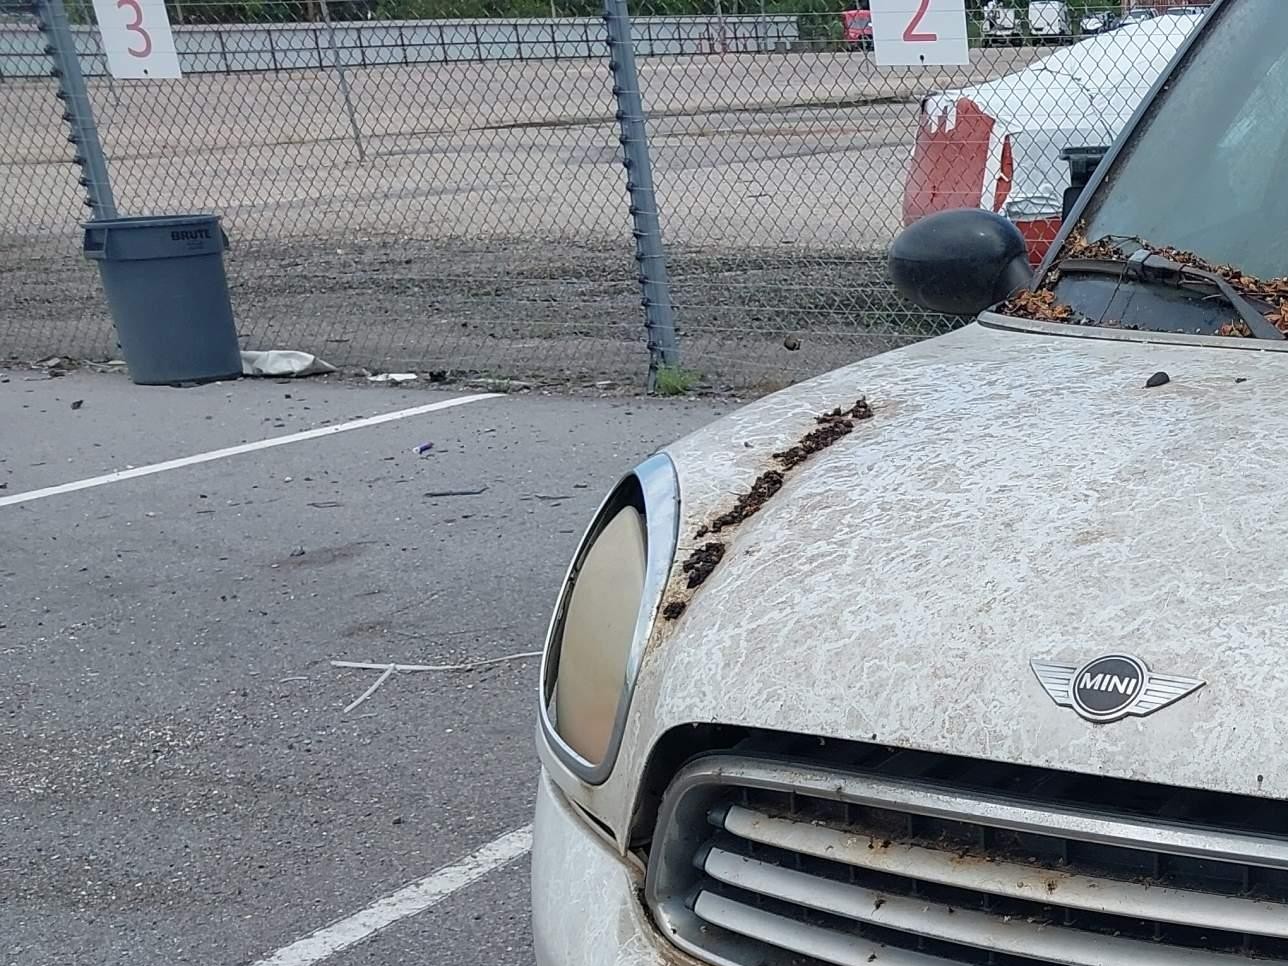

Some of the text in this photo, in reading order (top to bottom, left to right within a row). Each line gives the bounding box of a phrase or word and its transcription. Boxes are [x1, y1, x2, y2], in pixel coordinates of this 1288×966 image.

[117, 0, 152, 57] 3
[903, 0, 937, 41] 2
[171, 229, 211, 241] BRUTE
[1080, 672, 1137, 696] MINI
